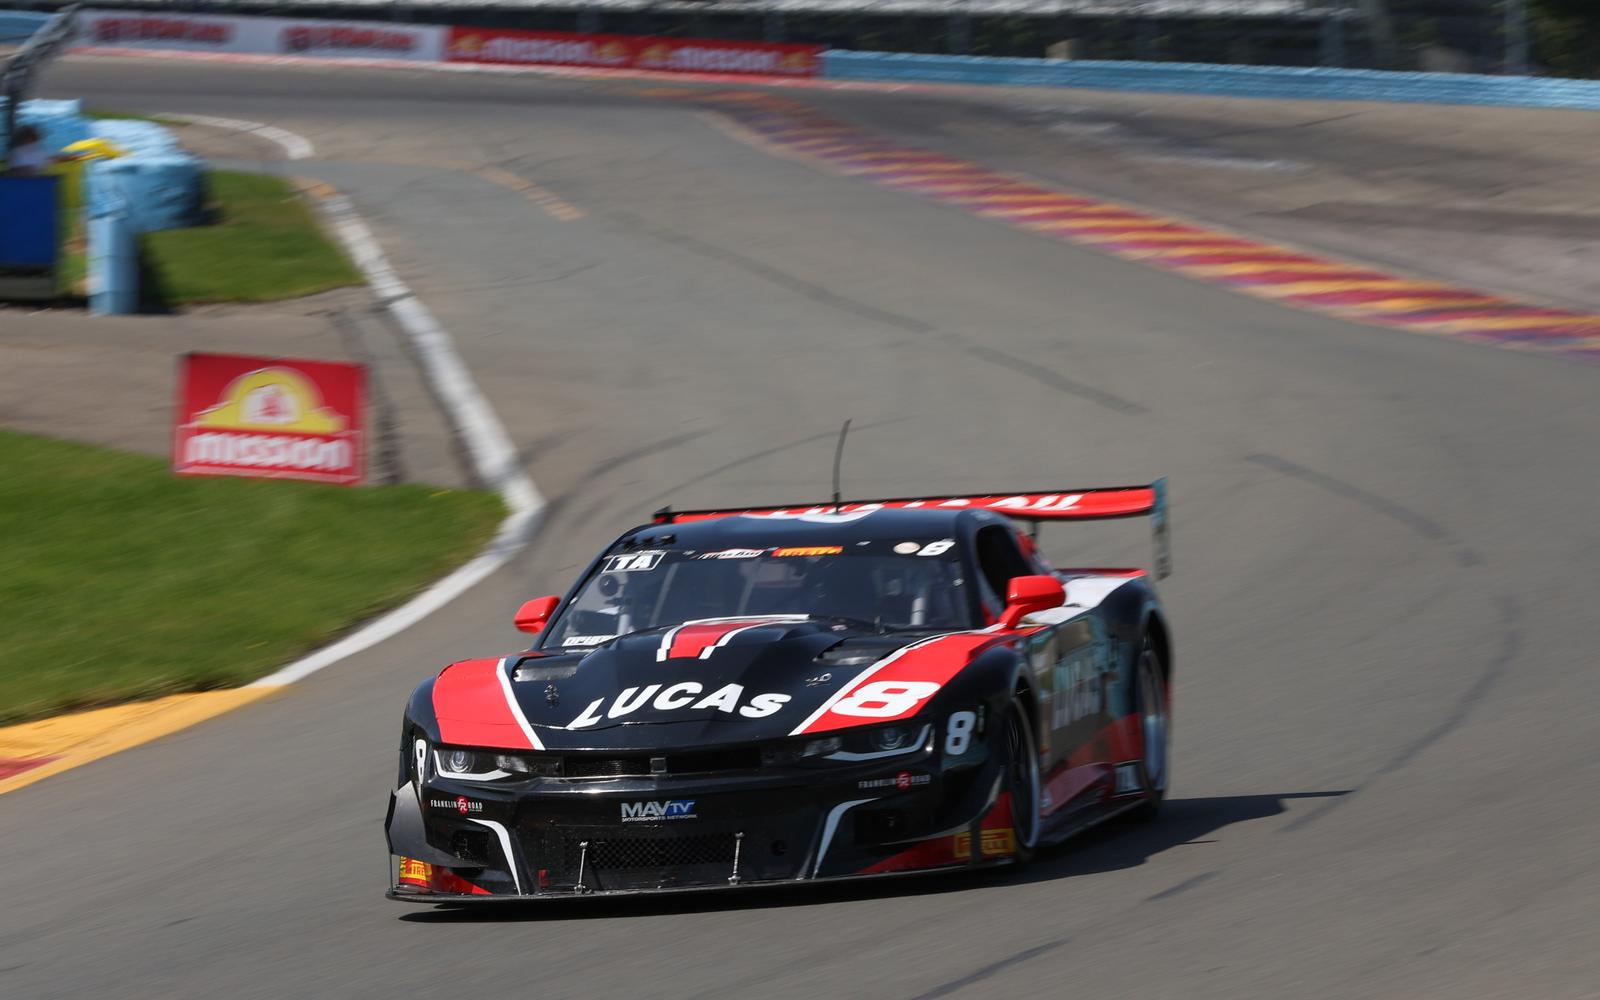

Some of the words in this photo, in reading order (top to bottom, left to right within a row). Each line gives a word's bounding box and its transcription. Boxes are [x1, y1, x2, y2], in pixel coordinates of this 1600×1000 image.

[915, 540, 956, 557] 8
[613, 554, 653, 572] TA
[566, 681, 792, 730] LUCAS
[830, 680, 941, 718] 8
[945, 710, 976, 756] 8
[430, 799, 458, 809] FRANKLIN
[467, 801, 483, 810] ROAD
